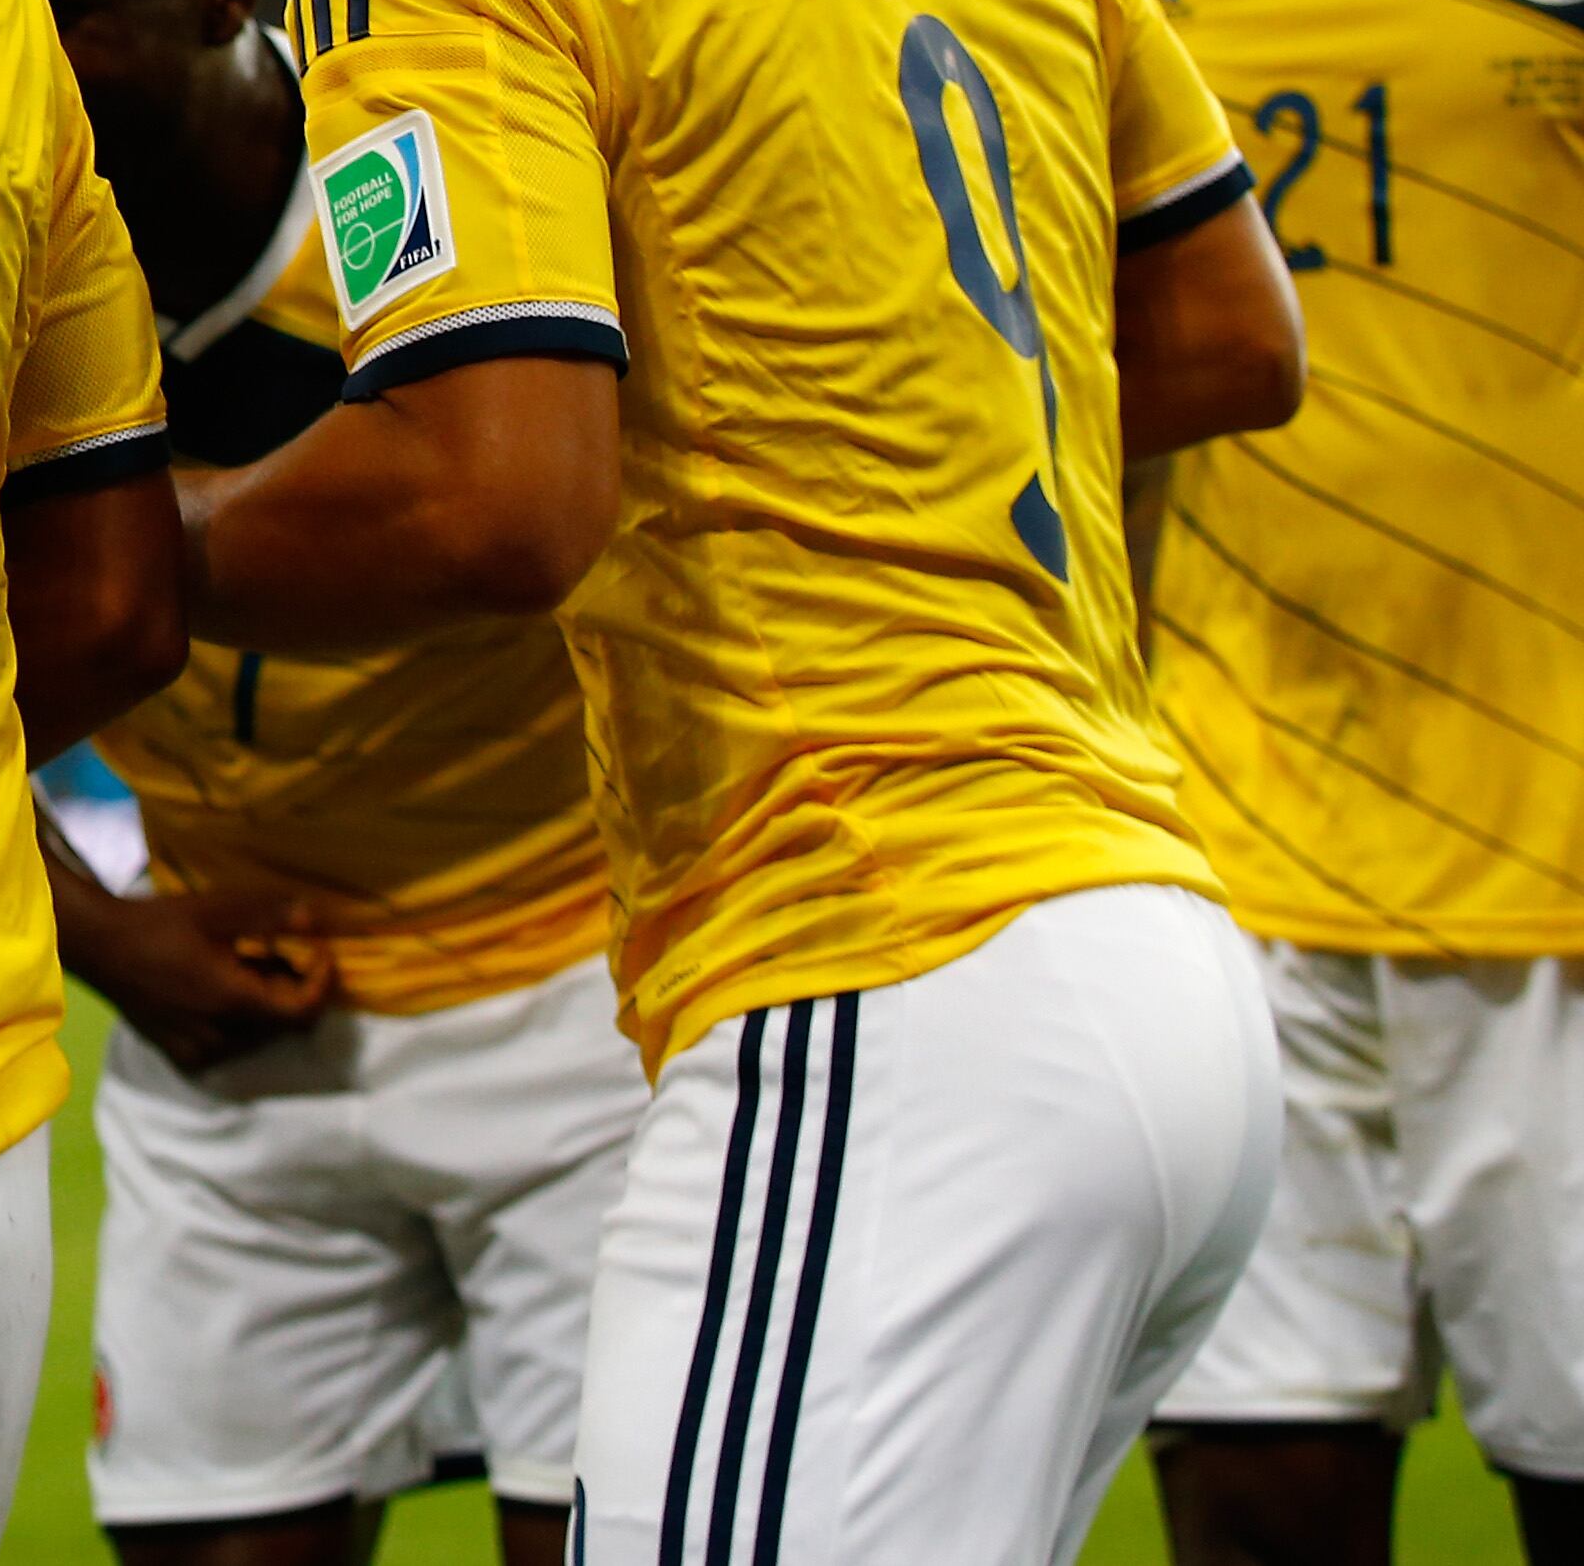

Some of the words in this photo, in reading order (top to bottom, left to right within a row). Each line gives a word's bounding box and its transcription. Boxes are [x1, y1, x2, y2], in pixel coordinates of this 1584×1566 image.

[334, 172, 392, 213] FOOTBALL
[1254, 82, 1393, 274] 21
[336, 206, 359, 229] FOR
[360, 186, 392, 213] HOPE
[399, 246, 431, 270] FIFA
[898, 13, 1069, 584] 9
